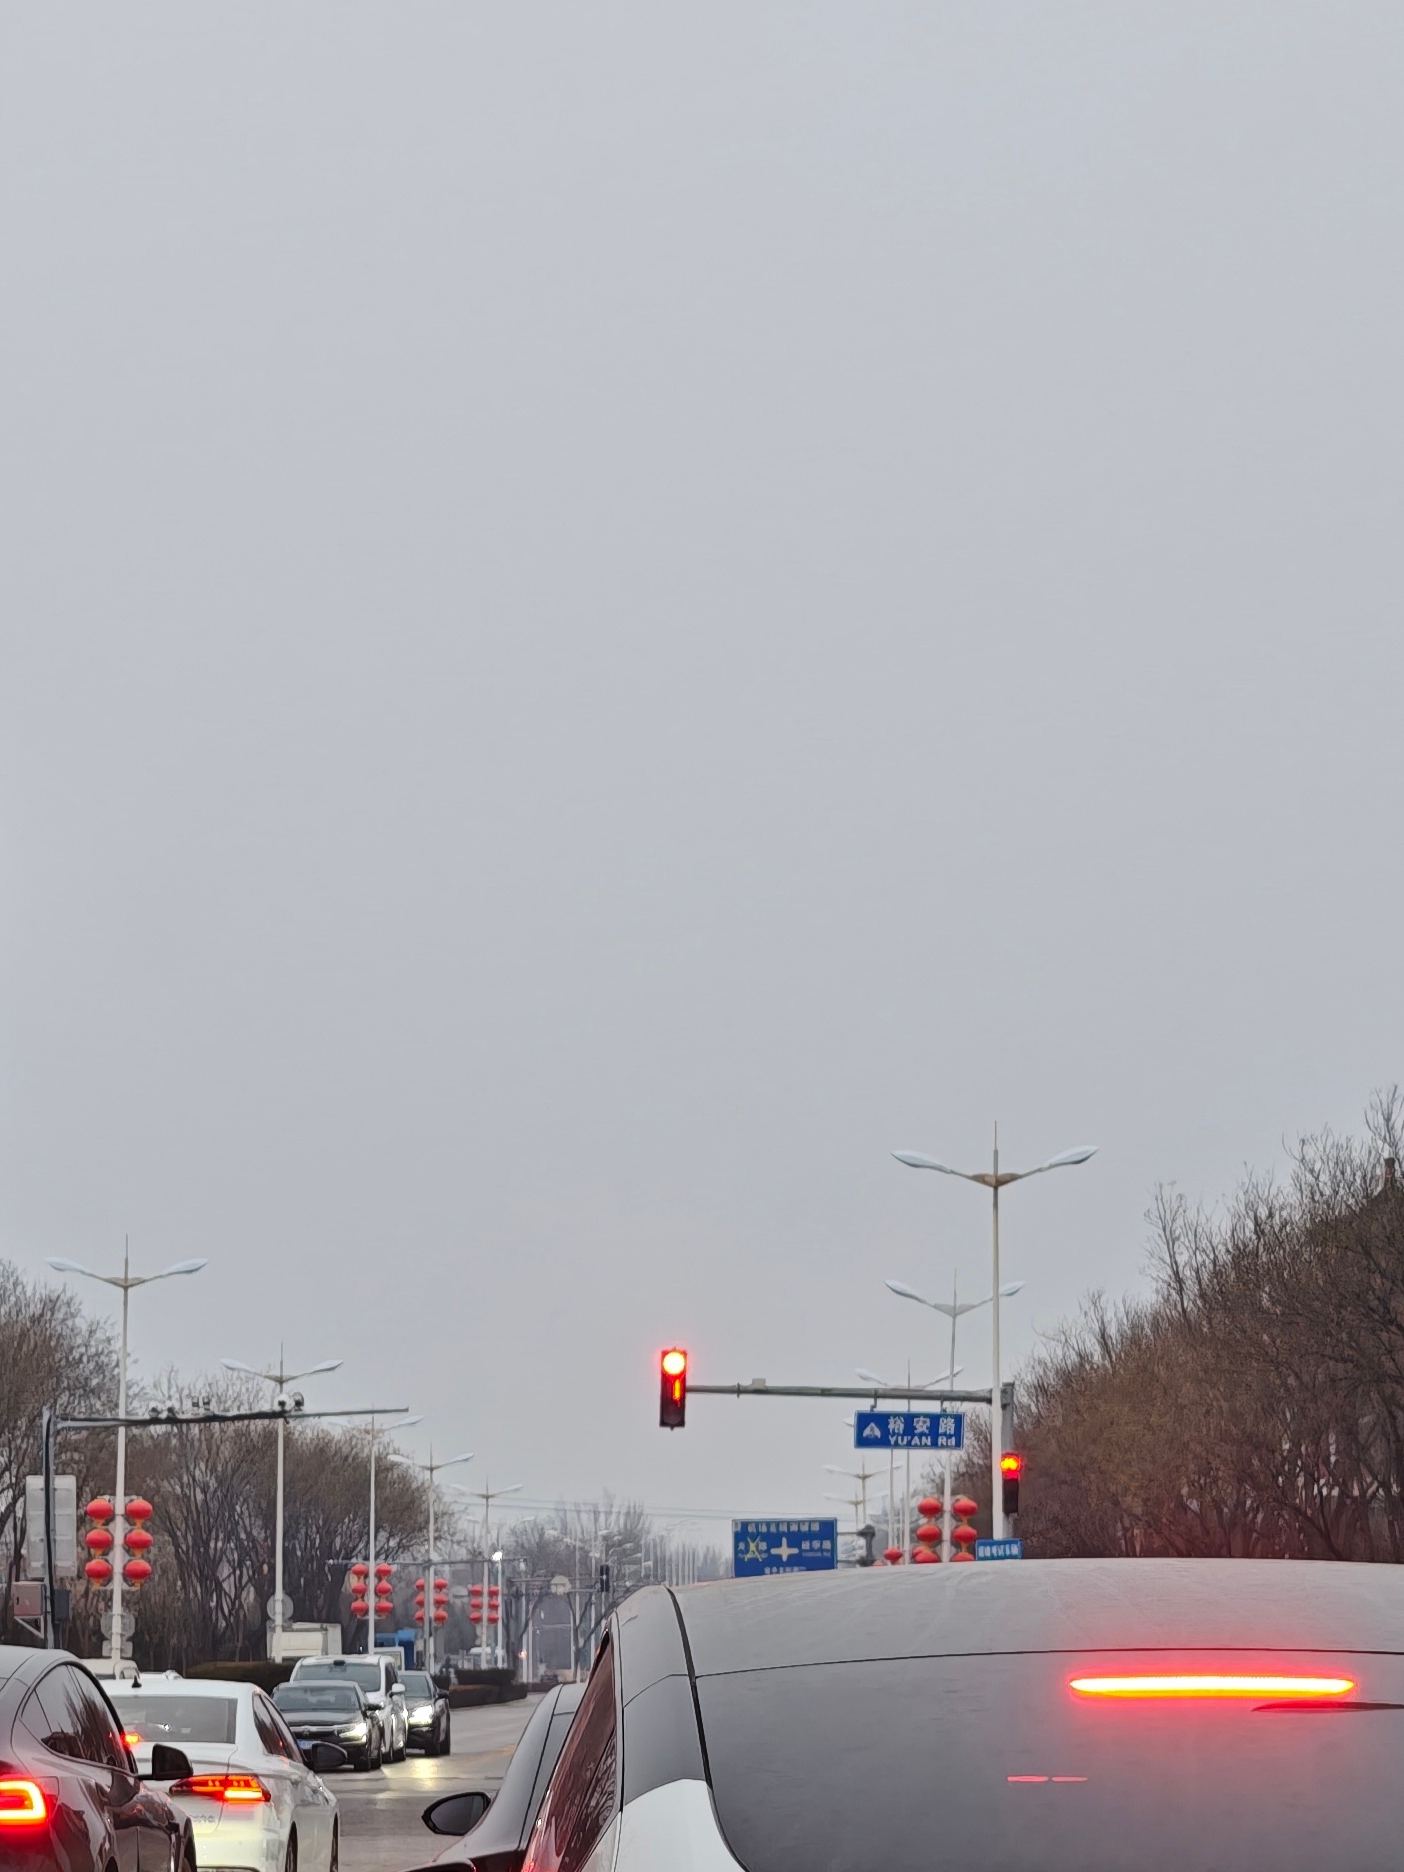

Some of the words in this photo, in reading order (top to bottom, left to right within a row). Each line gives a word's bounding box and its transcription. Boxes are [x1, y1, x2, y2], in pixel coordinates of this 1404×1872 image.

[888, 1416, 955, 1435] 裕安路
[889, 1435, 931, 1446] YU'AN
[938, 1436, 956, 1447] Rd
